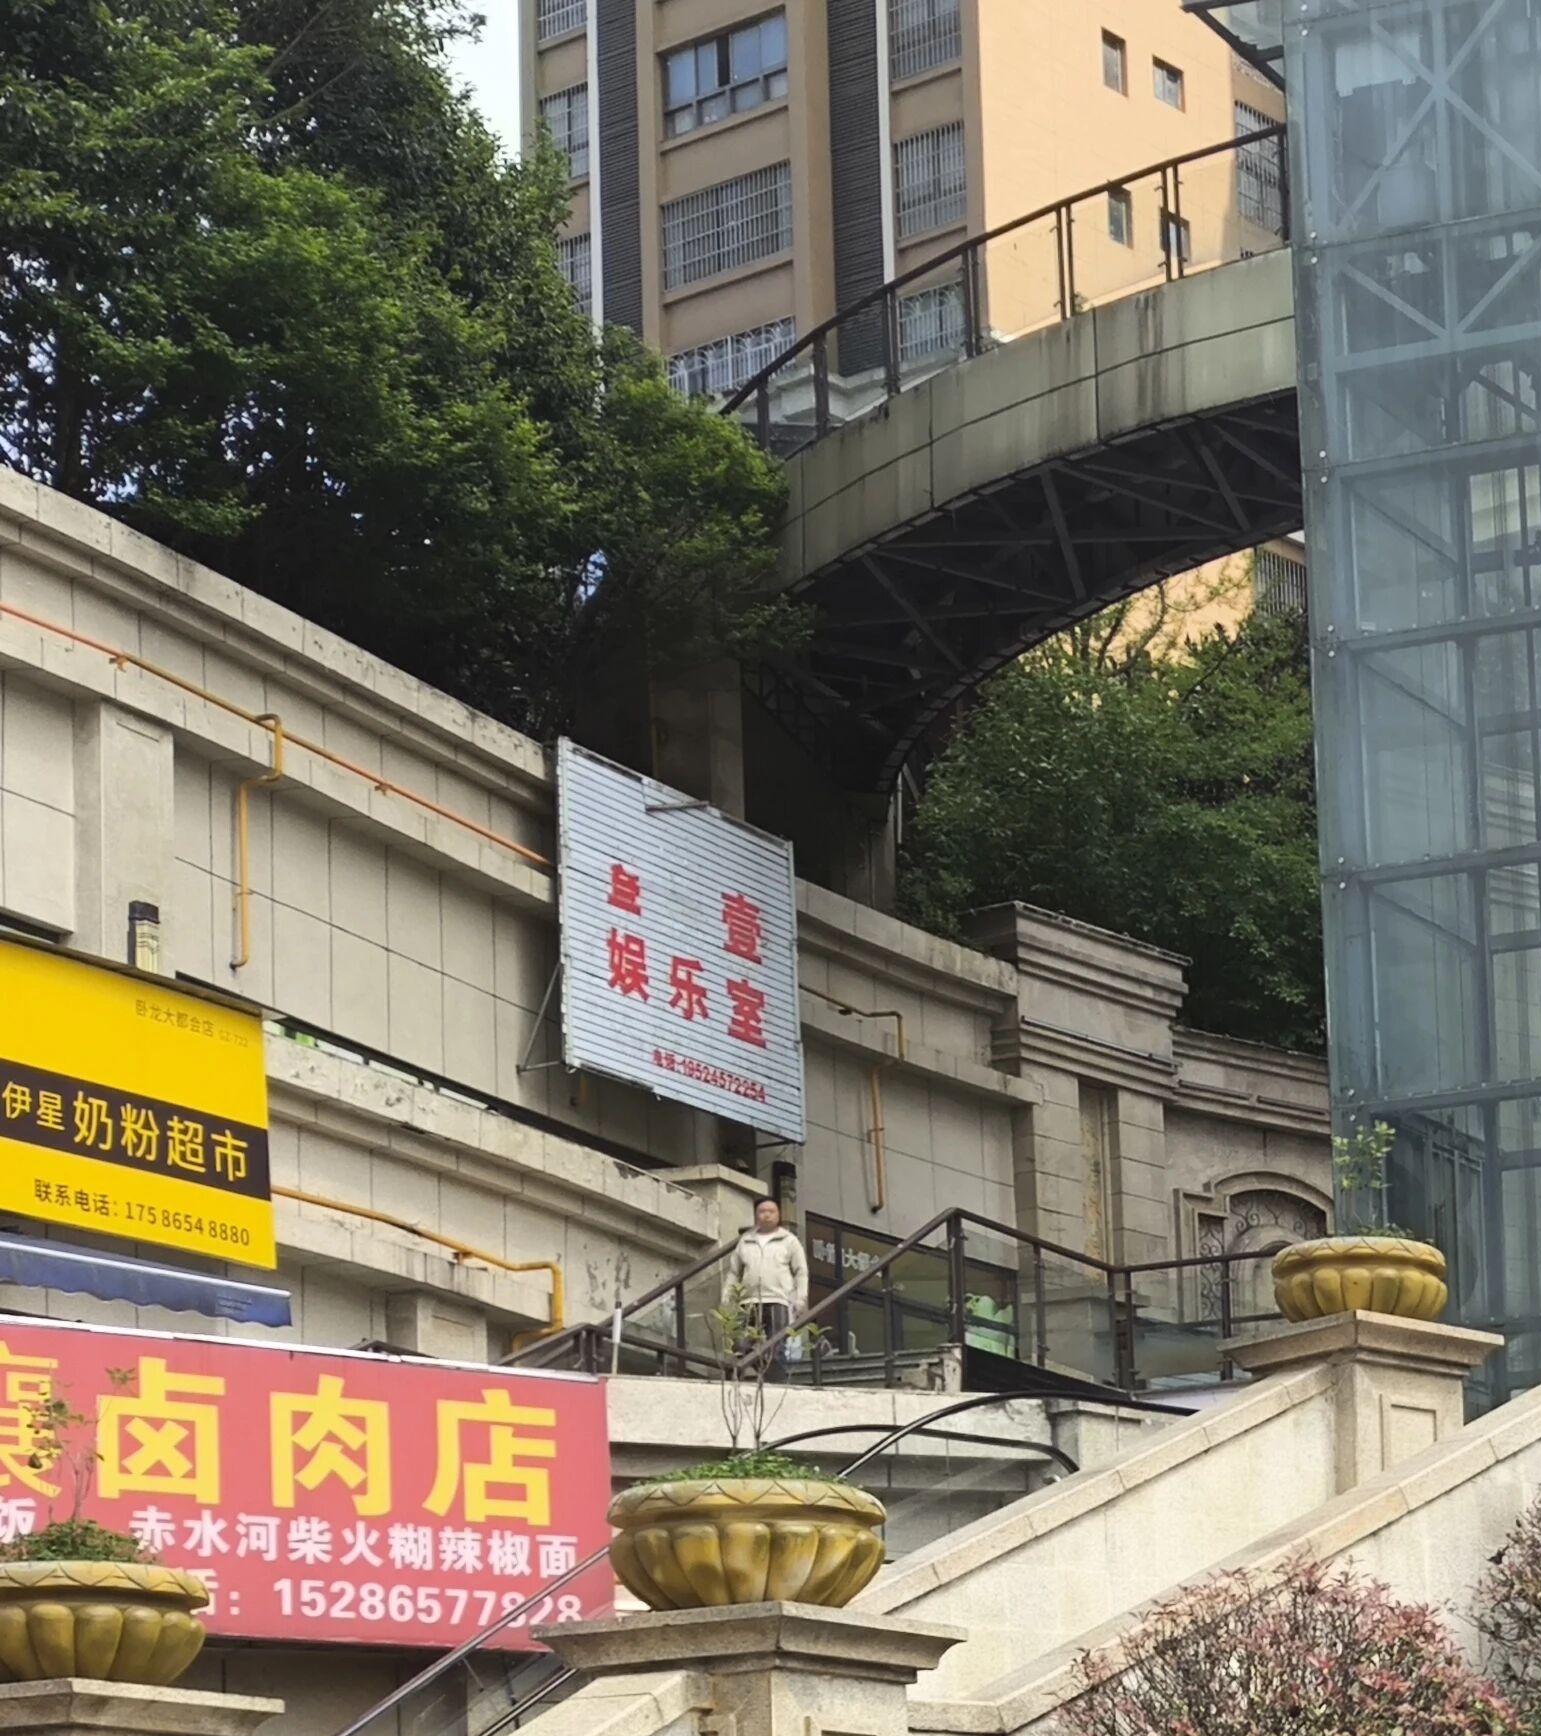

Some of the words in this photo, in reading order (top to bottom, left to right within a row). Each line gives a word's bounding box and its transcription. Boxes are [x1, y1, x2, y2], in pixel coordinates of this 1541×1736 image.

[135, 999, 215, 1038] 卧龙大都会店
[606, 928, 767, 1049] 娱乐室
[2, 1081, 249, 1183] 伊星奶粉超市
[128, 1505, 579, 1579] 赤水河柴火糊辣椒面
[273, 1579, 583, 1628] 15286577828
